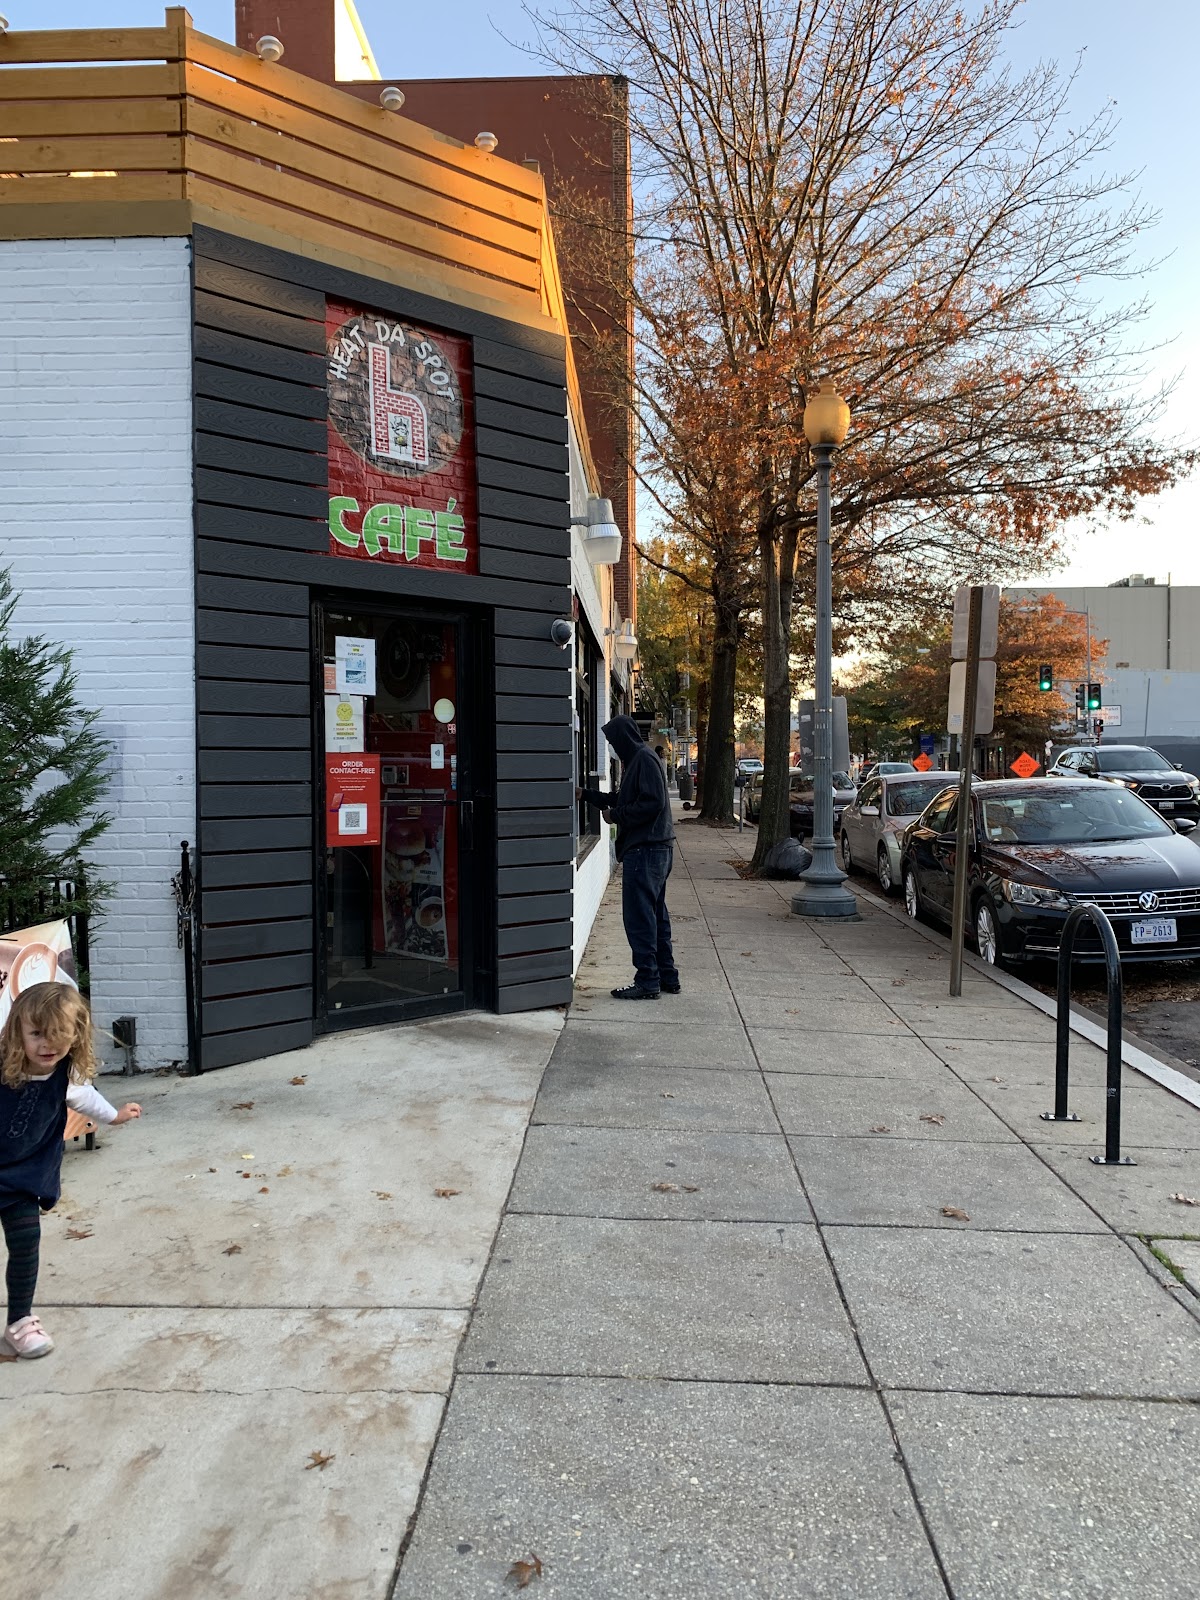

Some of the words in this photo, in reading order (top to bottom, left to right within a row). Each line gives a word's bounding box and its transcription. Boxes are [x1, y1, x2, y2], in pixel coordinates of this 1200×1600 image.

[328, 325, 365, 380] HEAT
[375, 321, 406, 347] DA
[415, 341, 455, 401] SPOT
[329, 495, 468, 562] CAFÉ
[341, 760, 364, 768] ORDER
[1152, 925, 1172, 937] 2613
